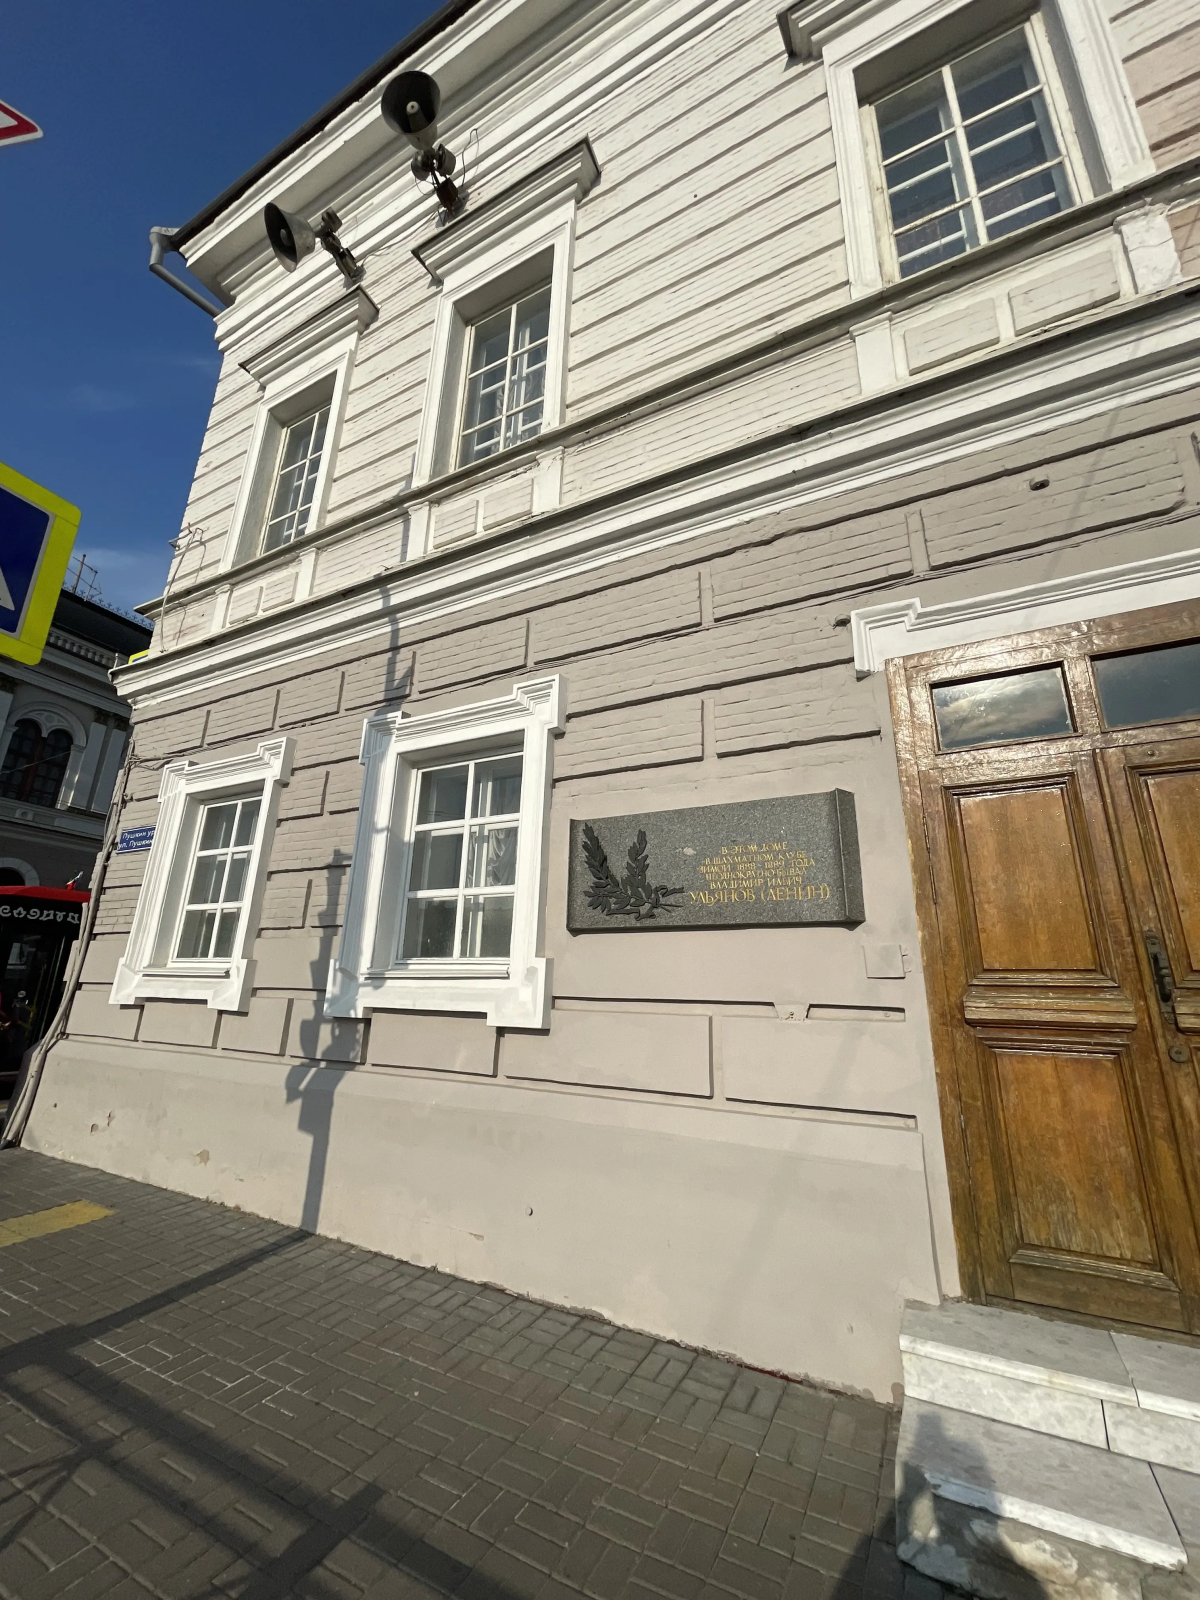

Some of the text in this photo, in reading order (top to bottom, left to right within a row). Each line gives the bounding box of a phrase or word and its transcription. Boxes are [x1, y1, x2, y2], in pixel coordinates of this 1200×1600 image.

[721, 841, 788, 855] В ЭТОМ ДОМЕ
[705, 850, 807, 865] В ШАХМАТНОМ КЛУБЕ
[710, 876, 802, 889] ВЛАДИМИР ИЛЬИЧ
[689, 882, 830, 906] УЛЬЯНОВ (ЛЕНИН)
